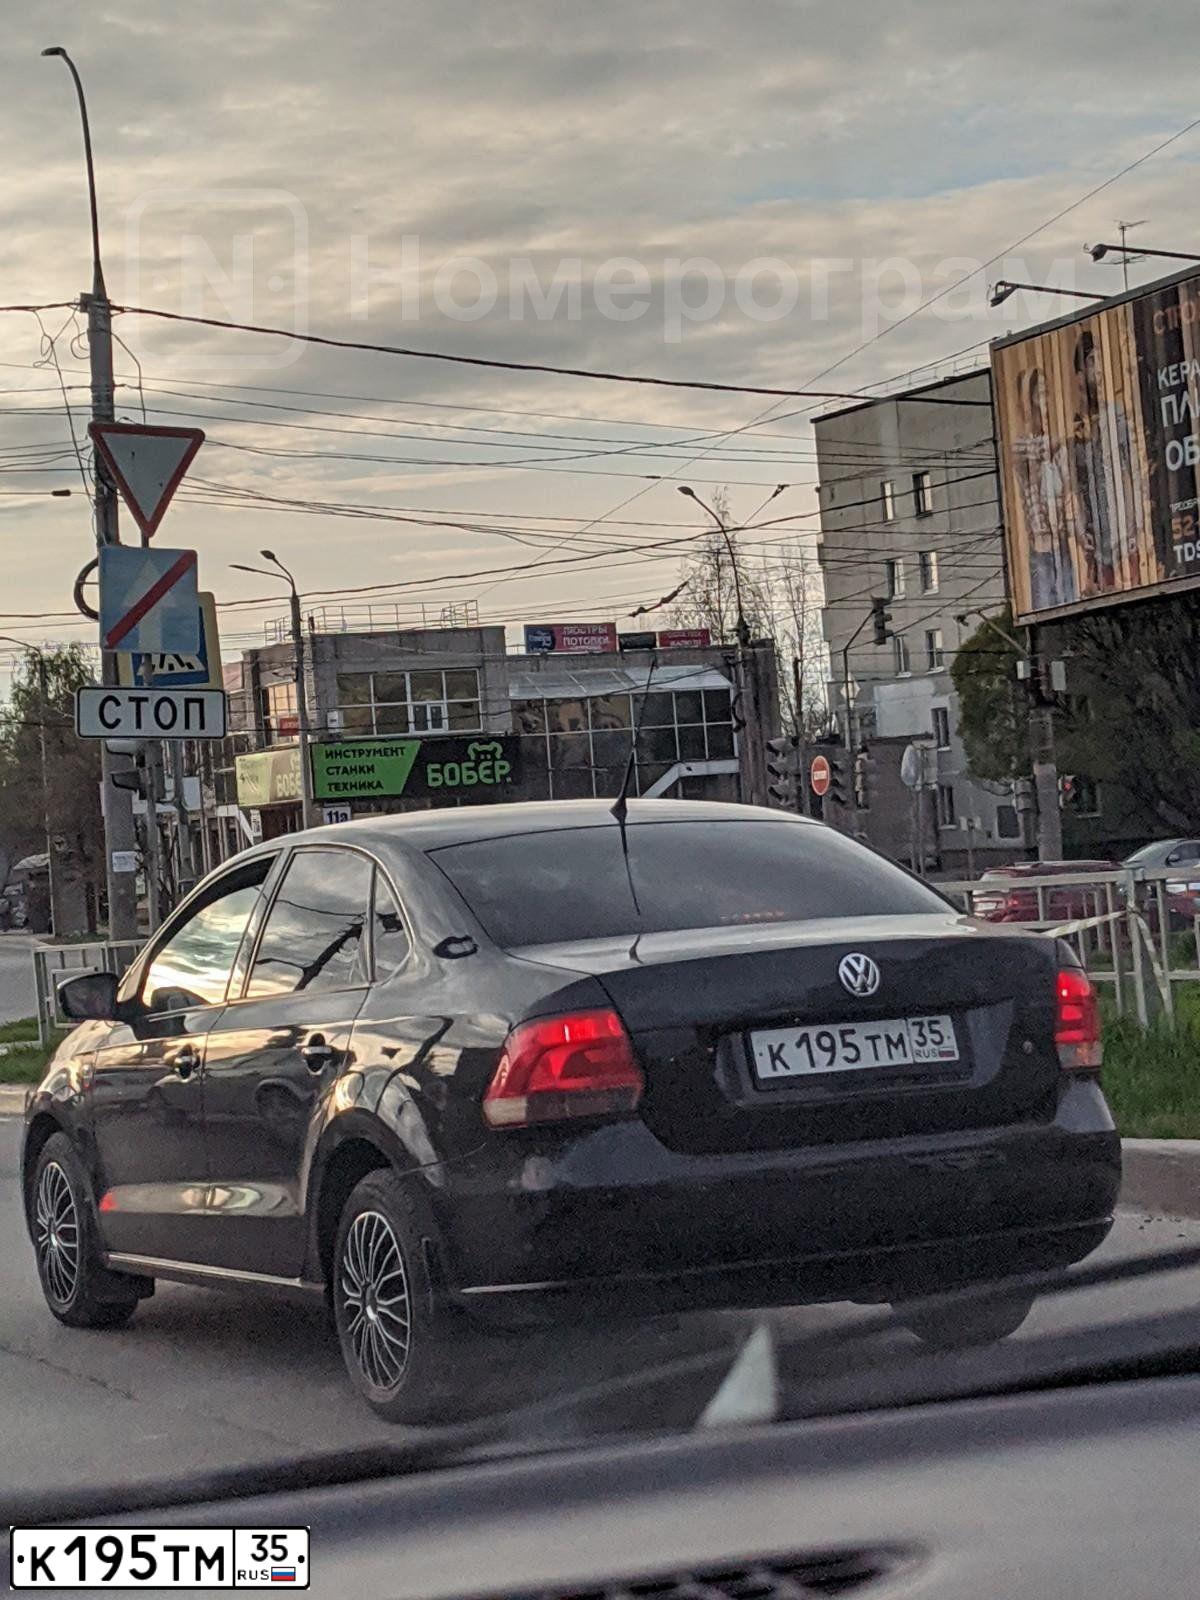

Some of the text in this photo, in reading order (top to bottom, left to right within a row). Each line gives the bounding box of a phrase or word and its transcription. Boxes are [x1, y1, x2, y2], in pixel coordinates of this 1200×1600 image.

[99, 695, 205, 730] СТОП
[325, 746, 406, 760] ИНСТРУМЕНТ
[326, 764, 375, 776] СТАНКИ
[327, 782, 384, 793] ТЕХНИКА
[767, 1020, 945, 1072] К195ТМ 35
[914, 1048, 938, 1058] RUS
